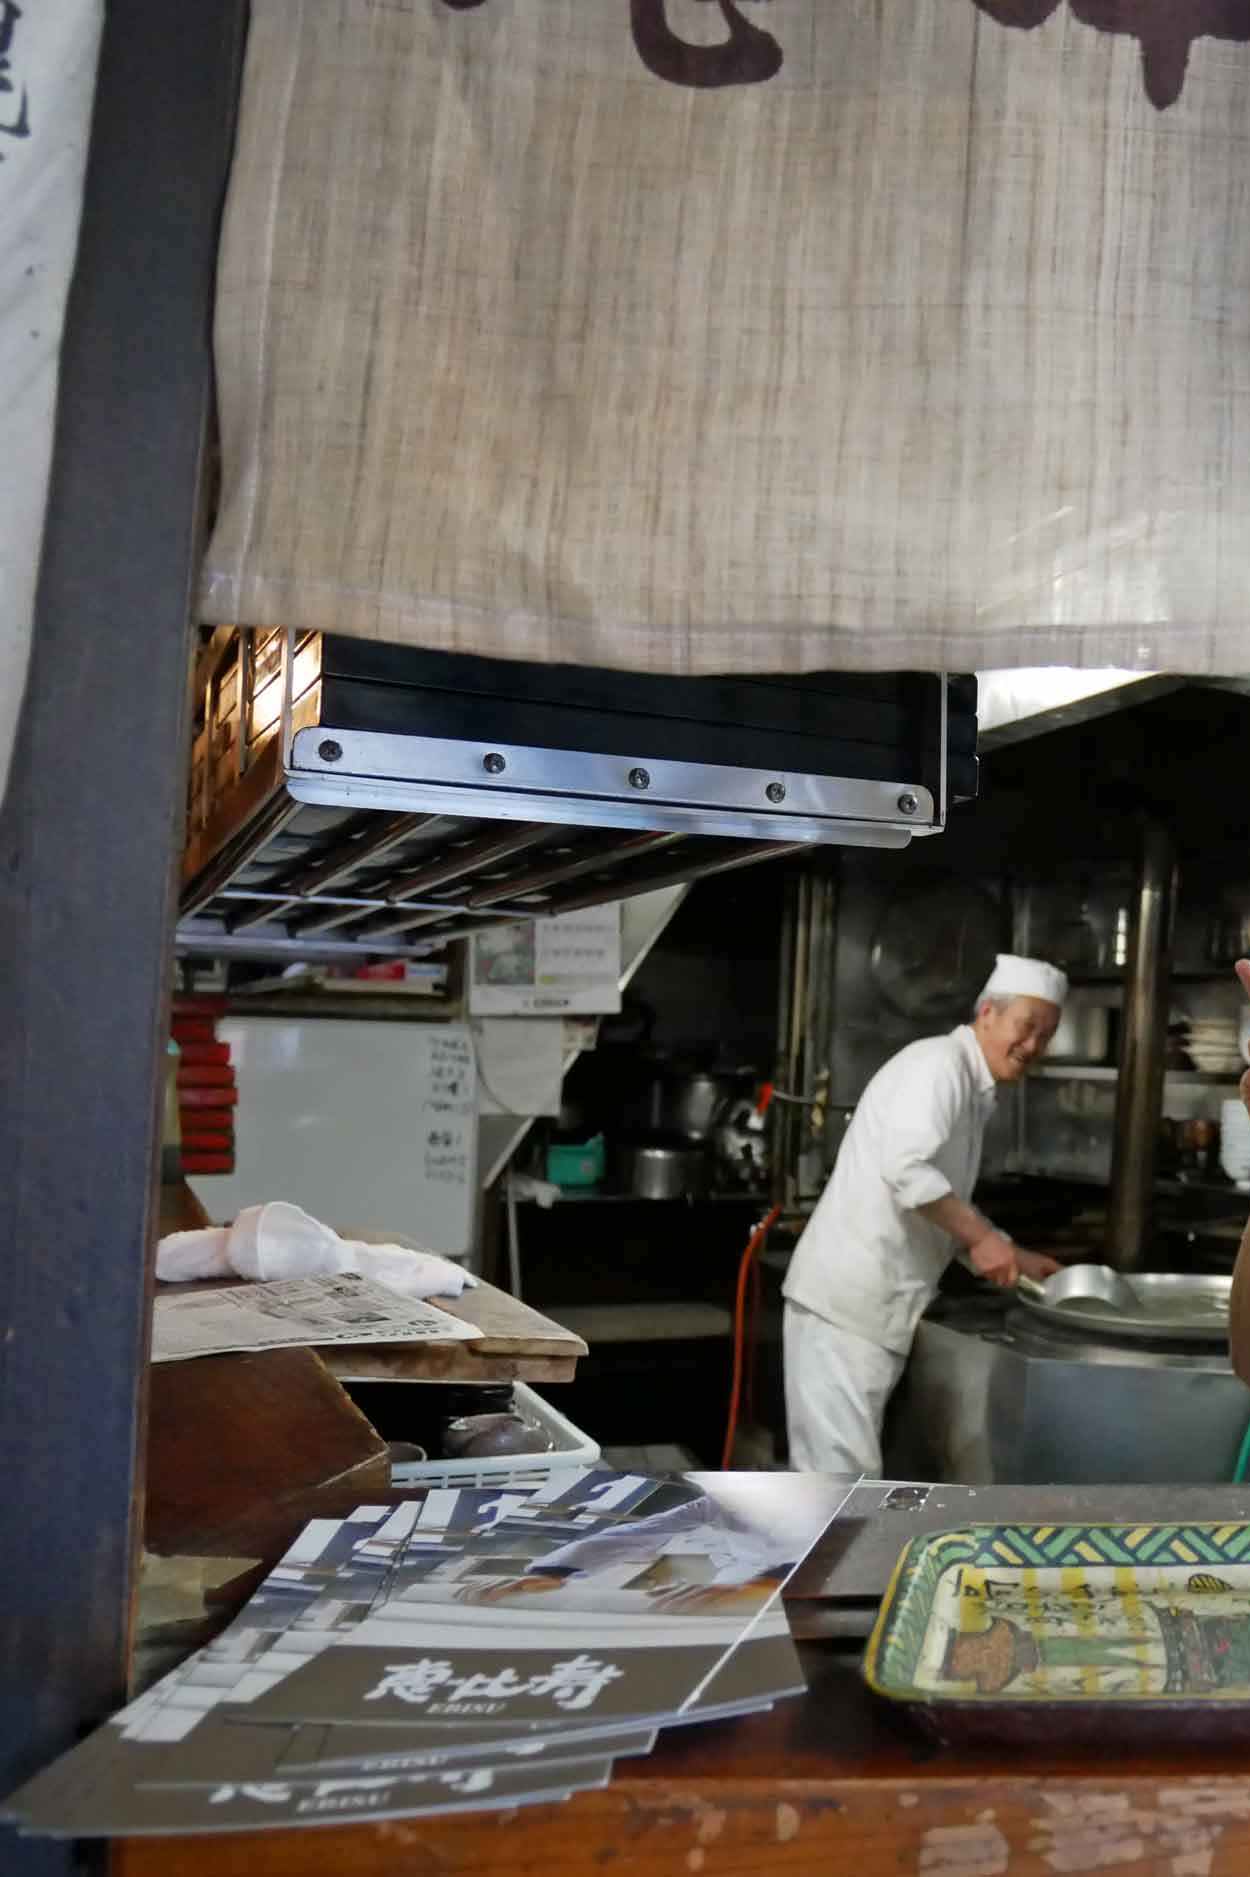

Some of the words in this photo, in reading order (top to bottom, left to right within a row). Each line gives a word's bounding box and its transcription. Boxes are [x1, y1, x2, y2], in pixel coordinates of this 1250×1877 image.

[363, 1653, 625, 1712] 恵比寿
[426, 1702, 506, 1716] EBISU
[363, 1755, 449, 1771] EBISU
[297, 1791, 392, 1813] EBISU
